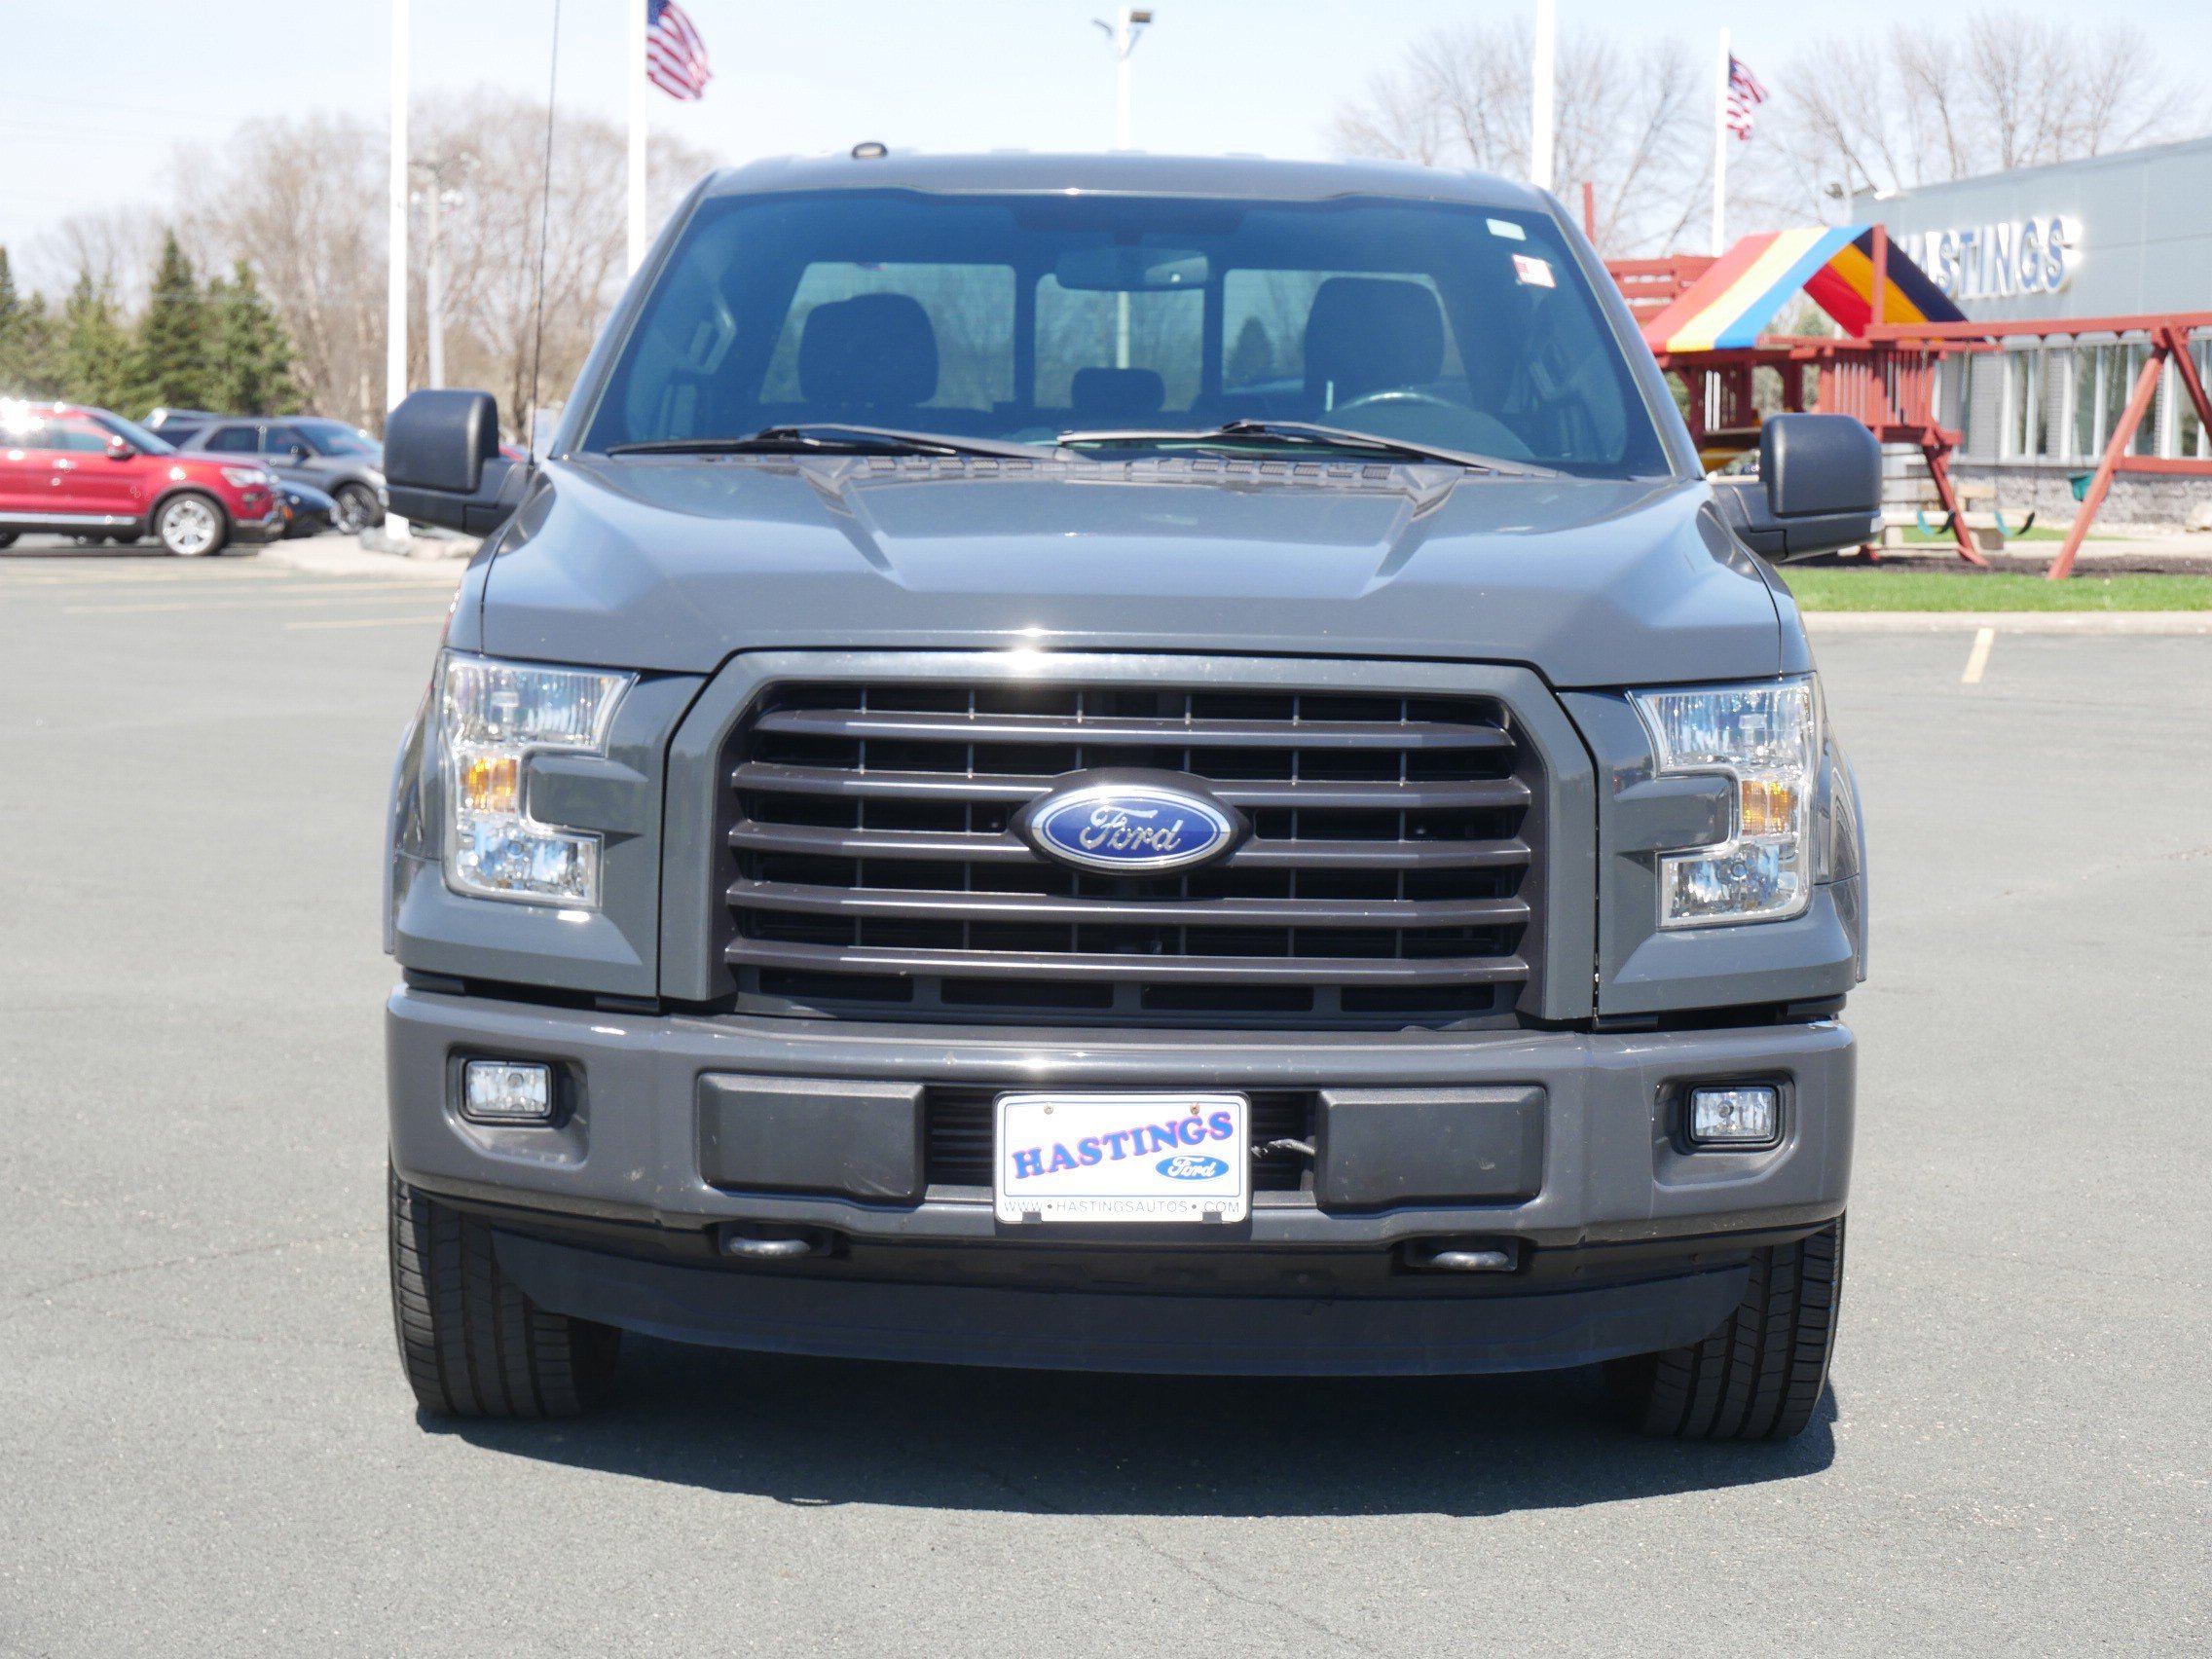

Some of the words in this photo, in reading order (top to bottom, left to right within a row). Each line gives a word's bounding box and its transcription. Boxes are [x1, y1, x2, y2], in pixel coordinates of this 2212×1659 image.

[1899, 218, 2081, 300] ASTINGS
[1079, 805, 1184, 851] Ford
[1012, 1111, 1234, 1179] HASTINGS
[1167, 1157, 1216, 1178] Ford
